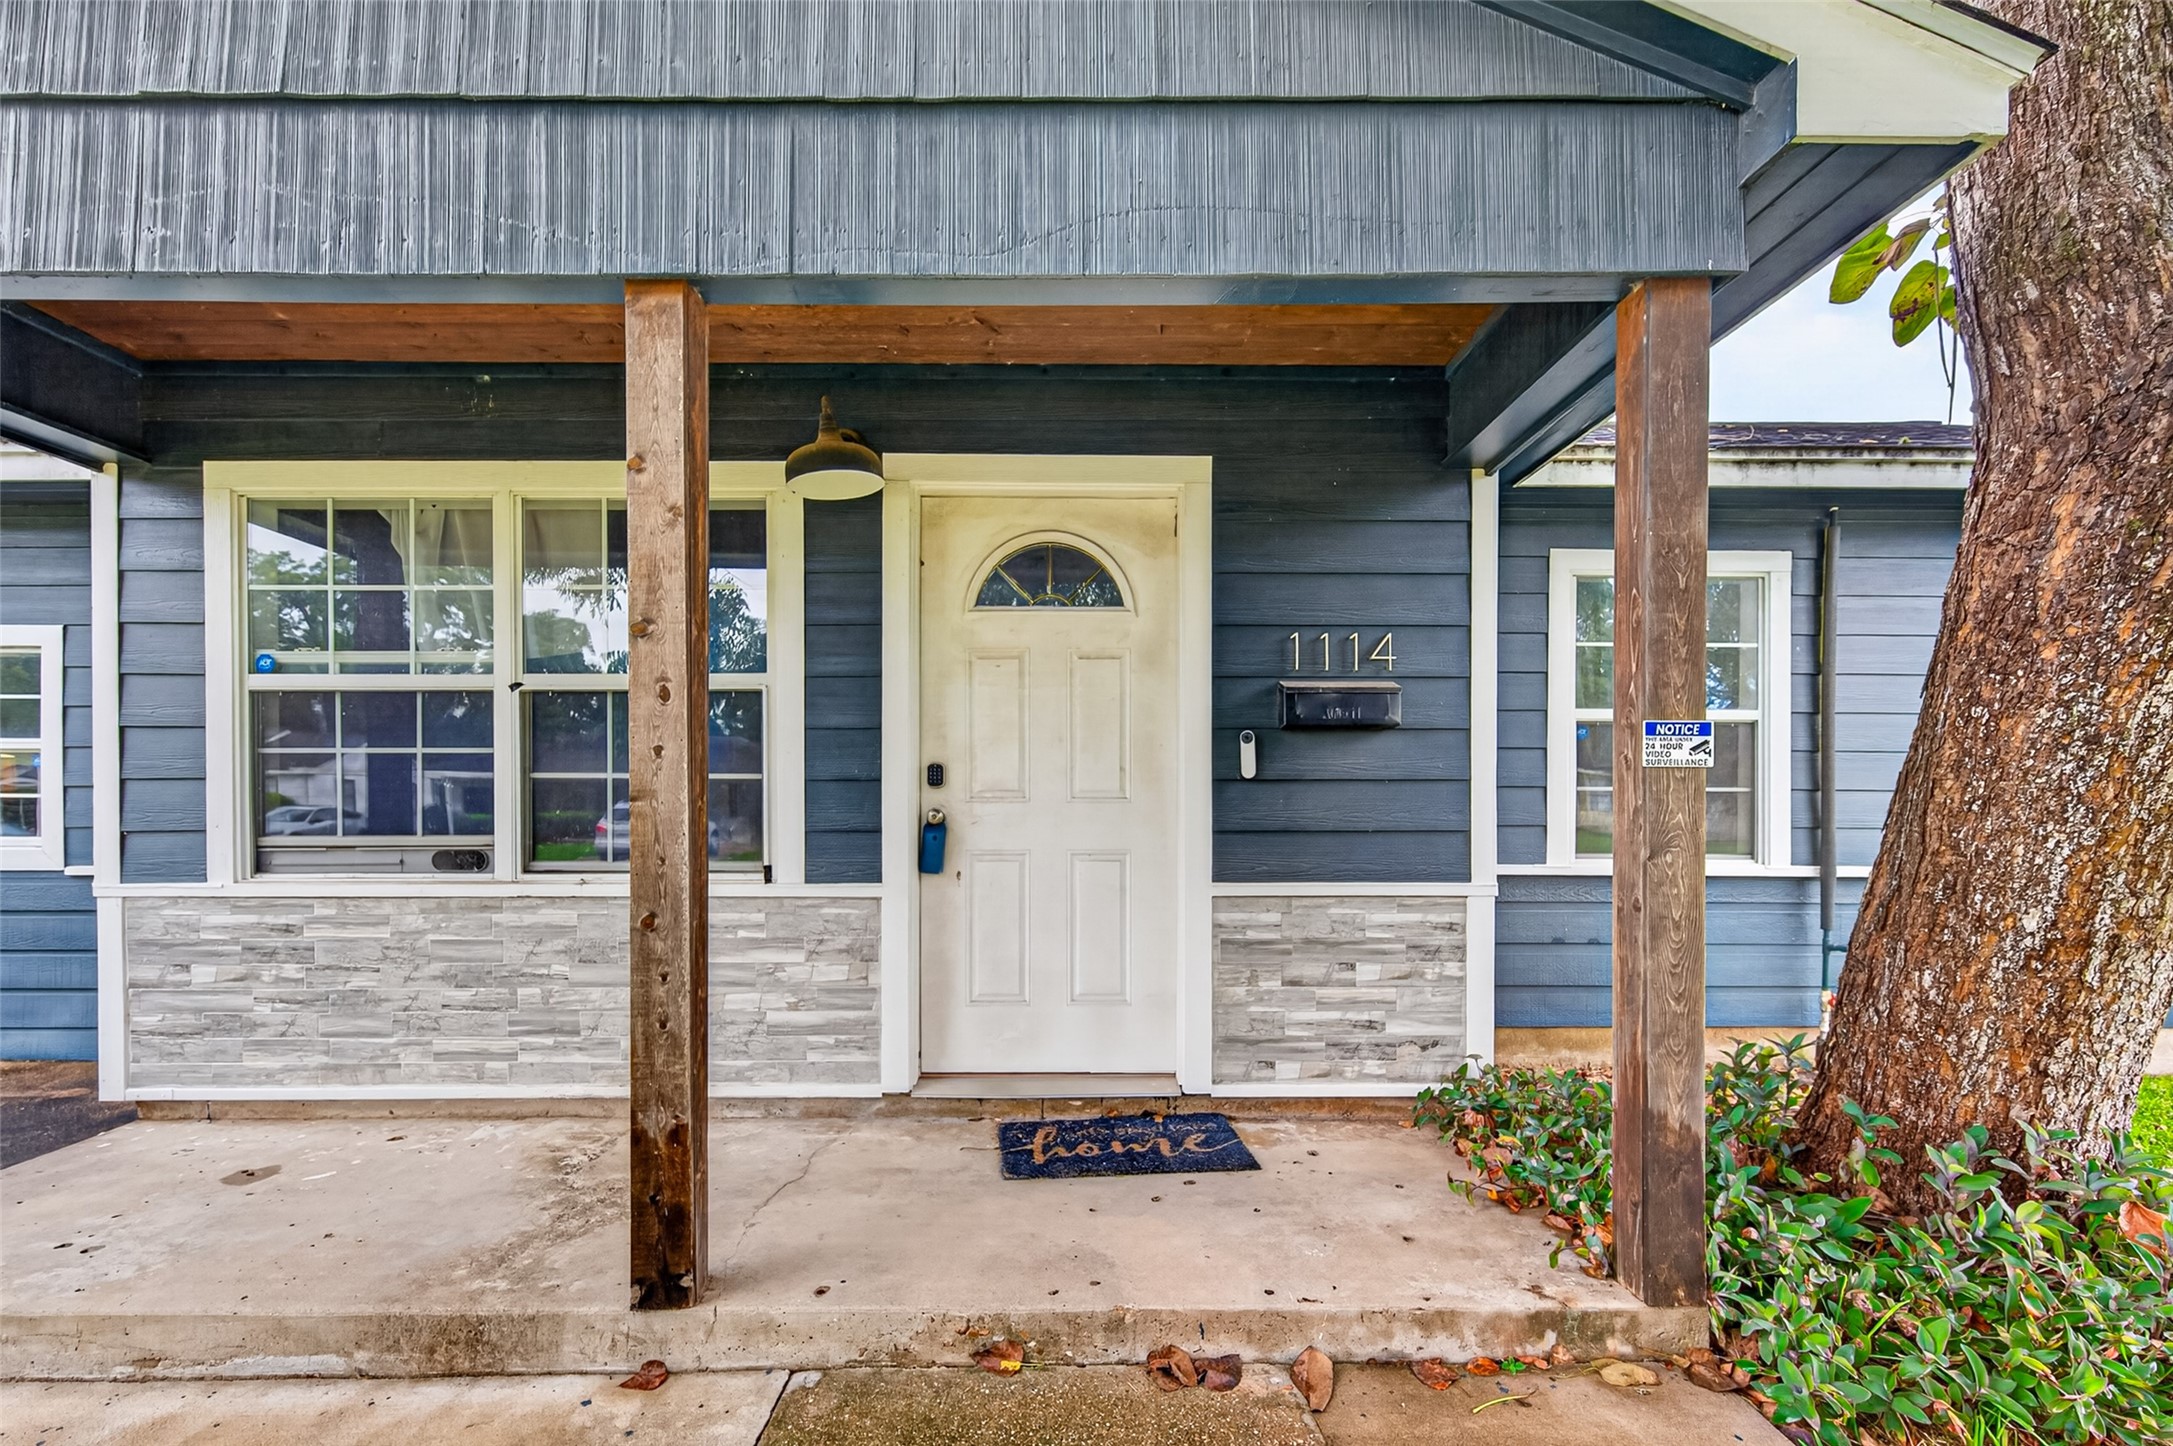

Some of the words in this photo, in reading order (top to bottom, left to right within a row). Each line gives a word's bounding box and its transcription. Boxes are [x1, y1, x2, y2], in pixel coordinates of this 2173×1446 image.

[1289, 631, 1398, 672] 1114
[1655, 723, 1701, 736] NOTICE
[1645, 742, 1656, 750] 24
[1659, 742, 1684, 750] HOUR
[1645, 750, 1672, 758] VIDEO
[1645, 758, 1709, 766] SURVEILLANCE
[1027, 1125, 1218, 1166] home
